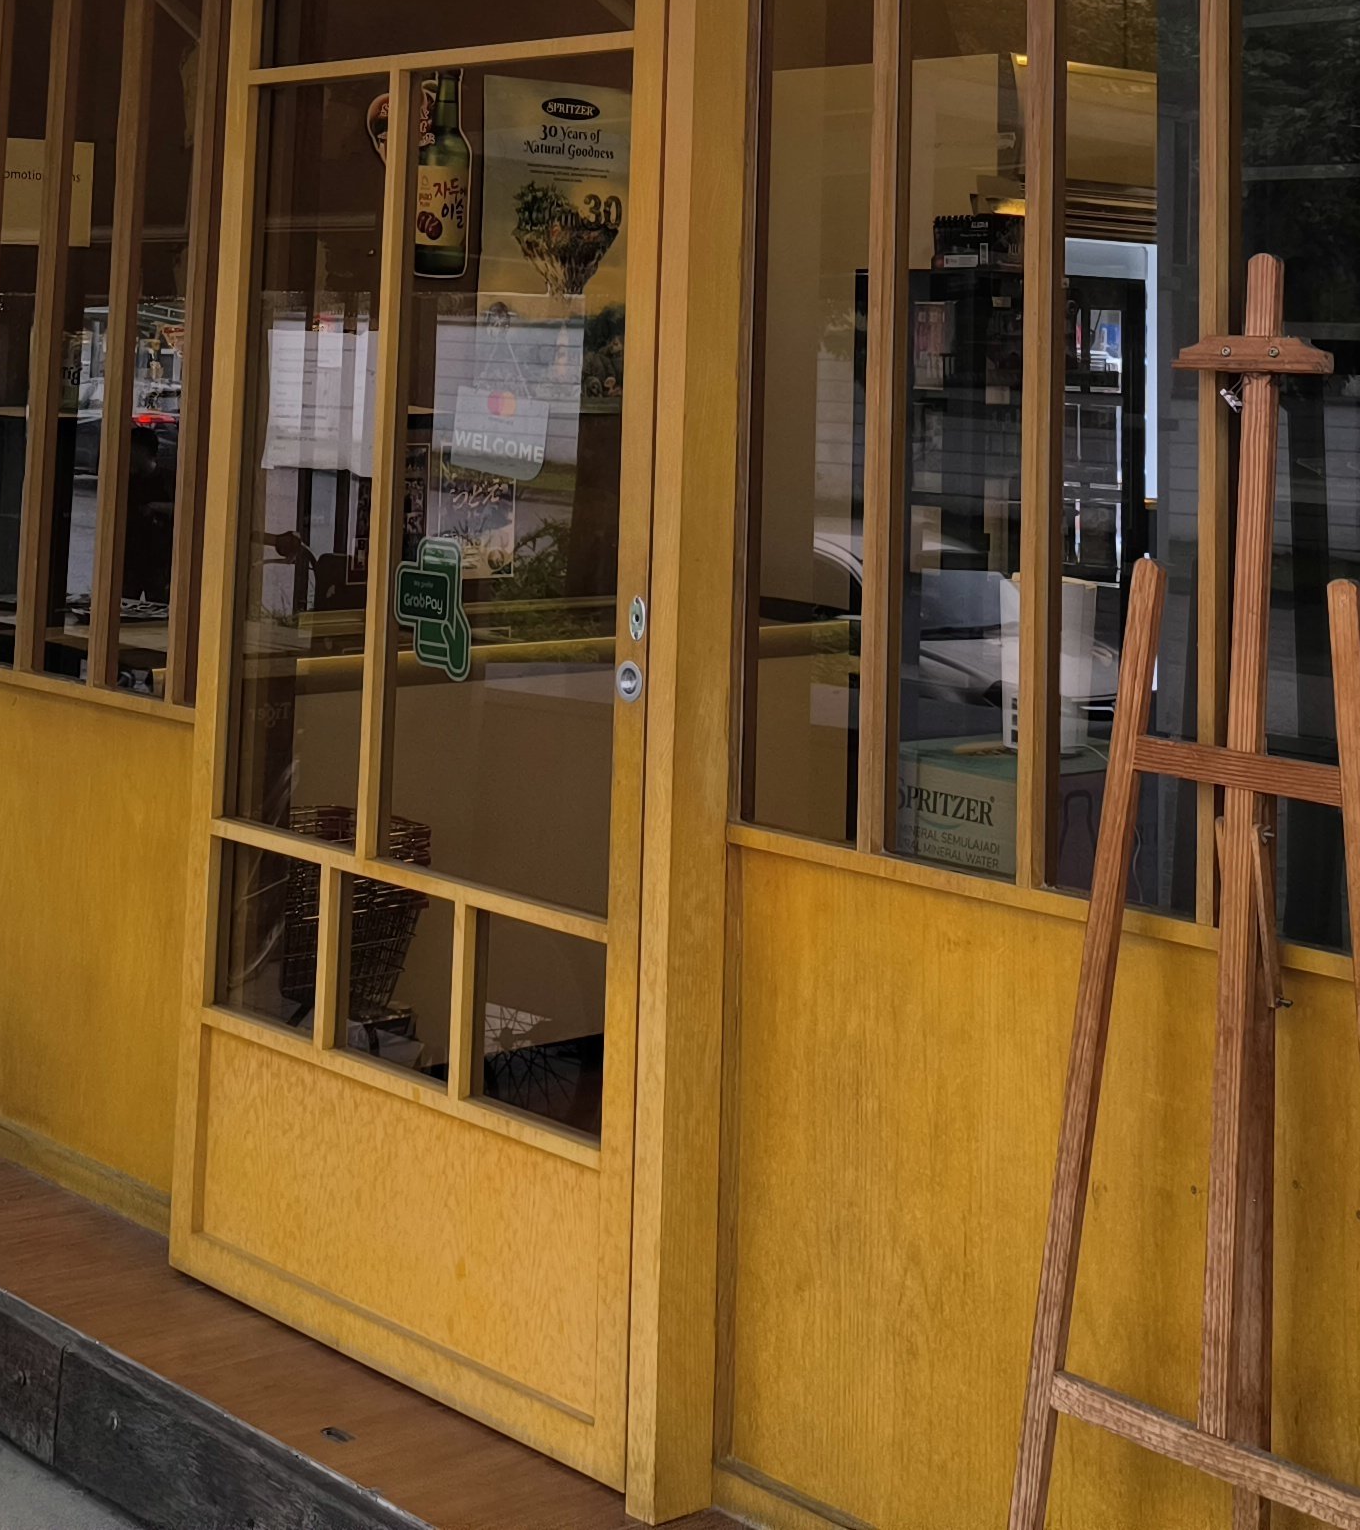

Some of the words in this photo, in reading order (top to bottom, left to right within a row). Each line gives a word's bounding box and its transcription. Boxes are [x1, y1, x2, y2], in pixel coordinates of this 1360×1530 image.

[546, 101, 595, 117] SPRITZER
[539, 124, 558, 141] 30
[559, 126, 588, 143] Years
[590, 129, 602, 144] of
[523, 139, 566, 155] Natural
[567, 144, 615, 160] Goodness
[583, 193, 624, 230] 30
[454, 430, 545, 464] WELCOME
[403, 592, 444, 615] GrabPay
[940, 831, 1001, 856] SEMULAJADI
[965, 851, 1000, 869] WATER
